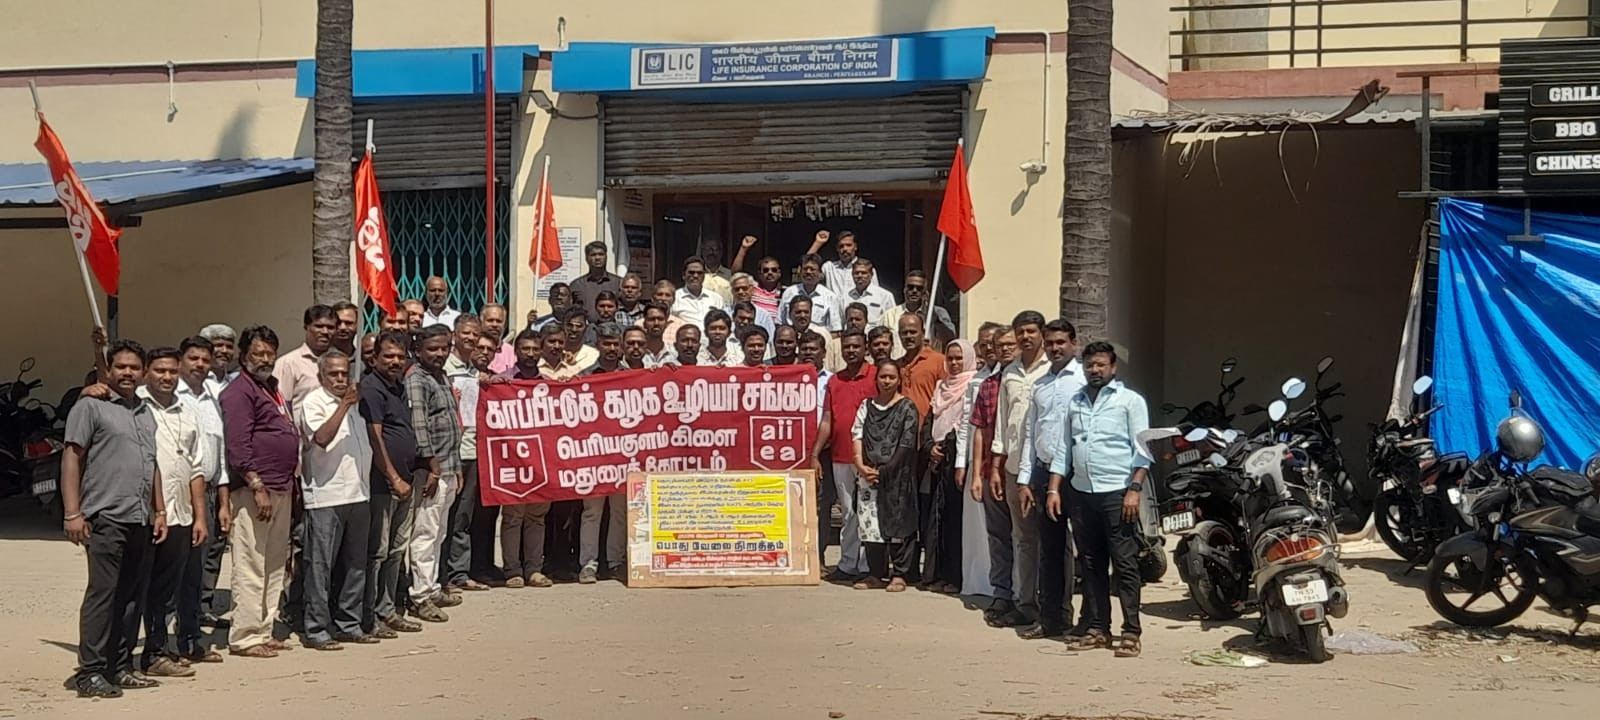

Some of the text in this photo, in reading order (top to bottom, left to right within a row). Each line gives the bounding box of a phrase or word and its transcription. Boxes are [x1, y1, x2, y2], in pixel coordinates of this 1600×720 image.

[668, 53, 695, 71] LIC
[712, 53, 757, 66] भारतीय
[764, 52, 801, 64] जीवन
[807, 50, 836, 63] बीमा
[842, 49, 878, 61] निगम
[711, 60, 878, 75] LIFE INSURANCE CORPORATION OF INDIA
[1549, 86, 1600, 102] GRILL
[1555, 121, 1597, 138] BBQ
[1536, 154, 1600, 171] CHINES
[486, 372, 817, 430] காப்பீட்டுக் கழக ஊழியர் சங்கம்
[556, 424, 738, 460] பெரியகுளம் கிளை
[656, 539, 784, 552] பொது வேலை நிறுத்தம்
